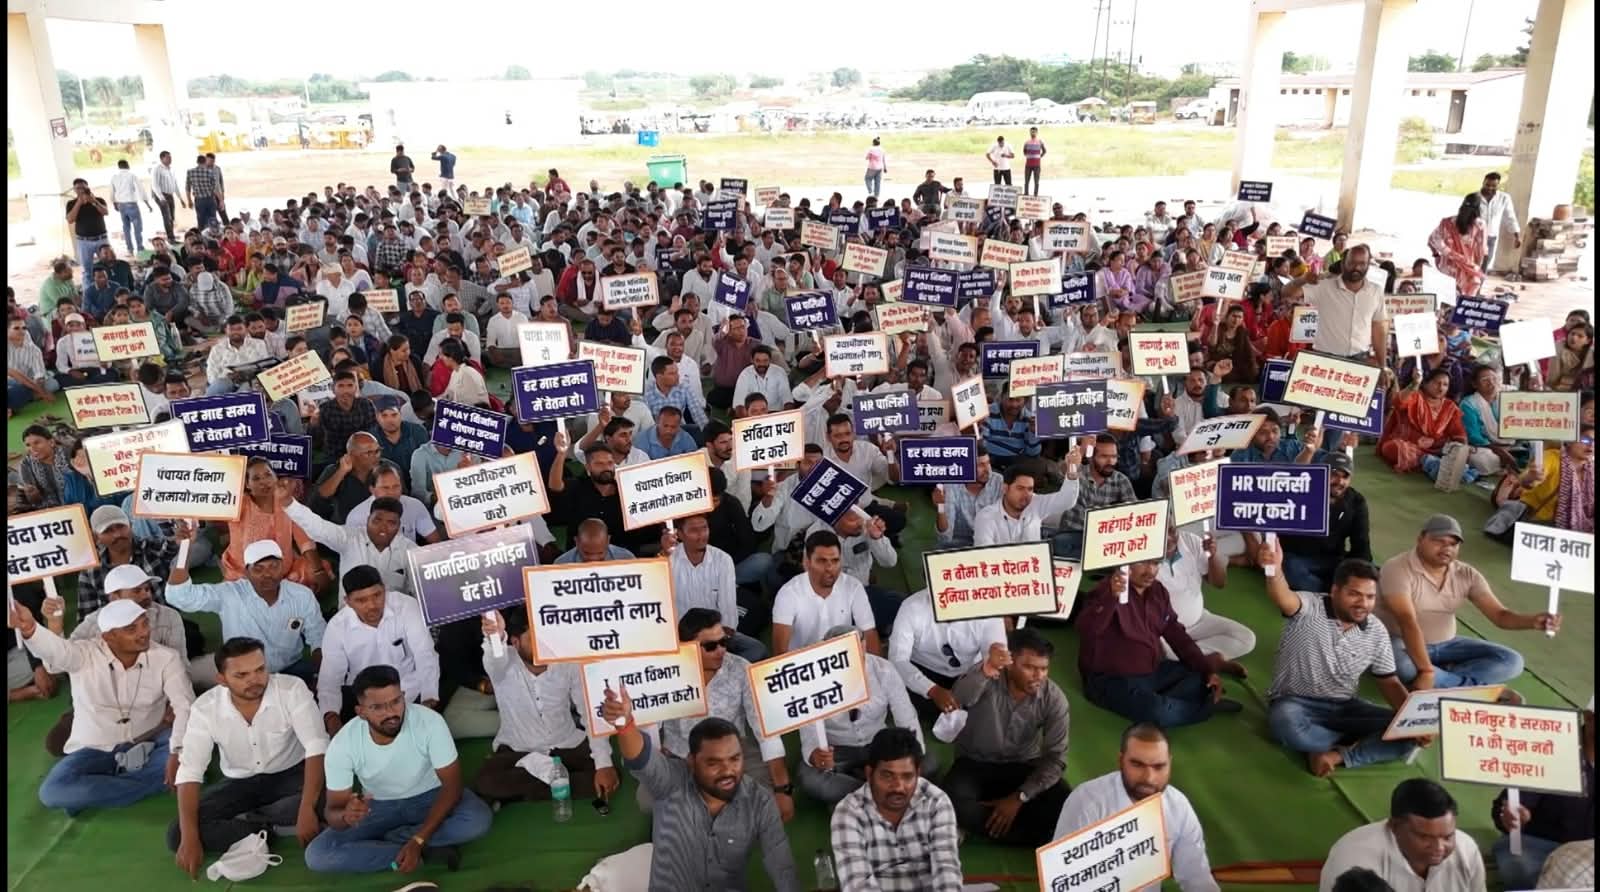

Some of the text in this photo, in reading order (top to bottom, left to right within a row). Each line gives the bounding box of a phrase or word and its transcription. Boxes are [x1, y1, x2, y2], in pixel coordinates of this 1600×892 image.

[1218, 283, 1228, 295] दो
[790, 302, 803, 314] HR
[540, 345, 551, 361] दो
[1164, 340, 1181, 351] भत्ता
[1145, 354, 1177, 370] लागू करो
[523, 371, 588, 393] हर माह समय
[1301, 364, 1311, 376] न
[1327, 367, 1335, 382] है
[1335, 372, 1343, 384] न
[1362, 374, 1372, 390] है
[531, 392, 586, 412] में वेतन दो।
[1038, 389, 1077, 410] मानसिक
[1290, 379, 1314, 396] दुनिया
[1313, 384, 1337, 402] भरका
[182, 402, 257, 424] हर माह समय
[859, 393, 911, 412] HR पालिसी
[443, 407, 468, 423] PMAY
[862, 416, 885, 432] लागू
[884, 413, 903, 426] करो
[1058, 413, 1072, 429] बंद
[1224, 420, 1254, 432] भत्ता
[192, 426, 206, 444] में
[206, 427, 233, 443] वेतन
[234, 423, 253, 440] दो।
[741, 421, 796, 443] संविदा प्रथा
[1206, 433, 1223, 447] दो
[750, 440, 789, 463] बंद करो
[906, 444, 969, 460] हर माह समय
[157, 467, 190, 483] पंचायत
[192, 467, 225, 484] विभाग
[454, 464, 518, 490] स्थायीकरण
[912, 461, 964, 478] में वेतन दो।
[634, 470, 692, 493] पंचायत विभाग
[1231, 471, 1313, 494] HR पालिसी
[142, 488, 236, 506] में समायोजन करो।
[448, 480, 537, 512] नियमावली लागू
[628, 487, 707, 516] में समायोजन करो।
[484, 505, 508, 522] करो
[1097, 511, 1158, 535] महंगाई भत्ता
[1232, 501, 1266, 526] लागू
[1266, 499, 1297, 522] करो
[37, 519, 74, 540] प्रथा
[32, 544, 69, 569] करो
[1102, 534, 1148, 560] लागू करो
[1520, 530, 1593, 560] यात्रा भत्ता
[422, 551, 480, 581] मानसिक
[942, 569, 953, 582] न
[979, 561, 989, 578] है
[989, 563, 1000, 577] न
[1030, 555, 1040, 573] है
[1545, 559, 1564, 583] दो
[461, 579, 503, 602] बंद हो।
[552, 572, 643, 597] स्थायीकरण
[937, 587, 970, 609] दुनिया
[971, 585, 1003, 601] भरका
[1004, 582, 1031, 598] टेंशन
[539, 601, 668, 627] नियमावली लागू
[587, 629, 621, 652] करो
[644, 665, 680, 683] विभाग
[764, 650, 851, 696] संविदा प्रथा
[671, 684, 700, 703] करो।
[784, 680, 845, 720] बंद करो
[1449, 706, 1472, 725] कैसे
[1508, 712, 1518, 728] है
[1519, 717, 1563, 734] सरकार
[1467, 734, 1484, 749] TA
[1487, 733, 1503, 750] की
[1504, 740, 1529, 756] सुन
[1479, 757, 1501, 773] रही
[1060, 816, 1140, 865] स्थायीकरण
[1051, 834, 1161, 892] नियमावली लागू
